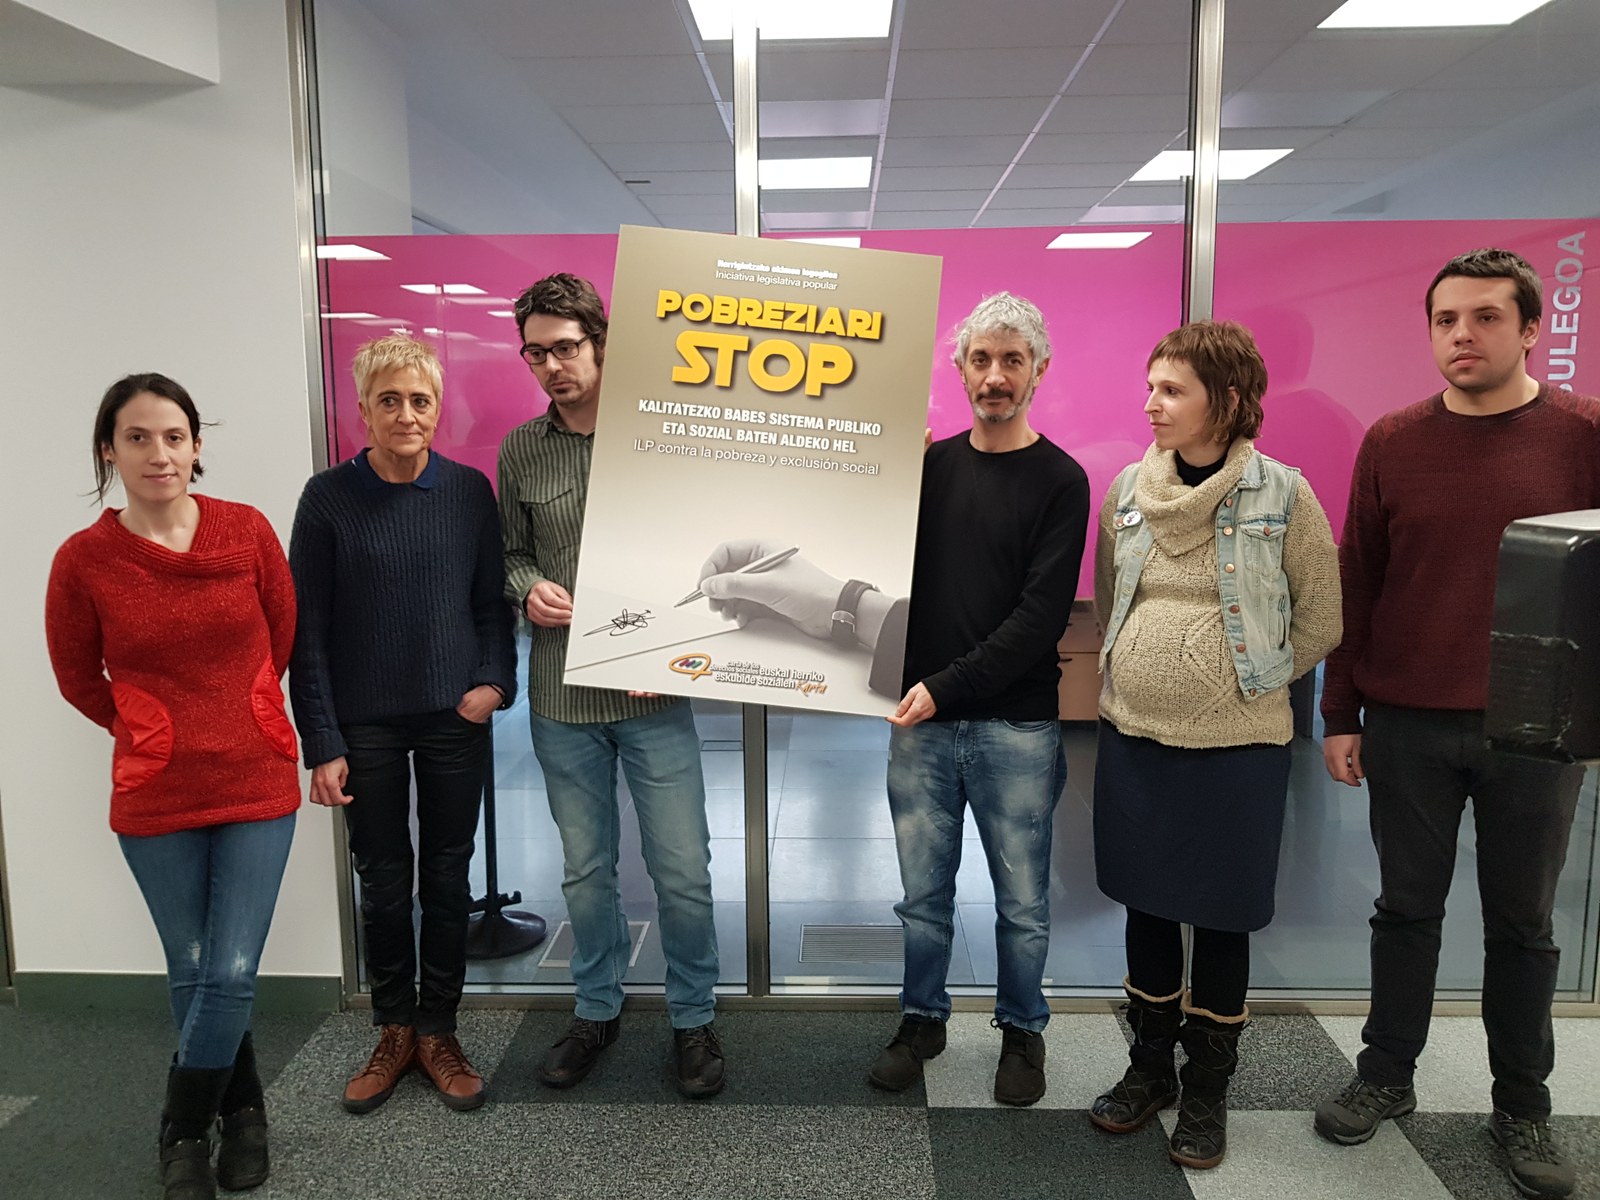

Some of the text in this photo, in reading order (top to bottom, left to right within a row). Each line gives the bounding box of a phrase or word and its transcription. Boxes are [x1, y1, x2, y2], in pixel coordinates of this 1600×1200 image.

[715, 270, 837, 291] Iniciativa legislativa popular
[656, 289, 882, 340] POBREZIARI
[671, 330, 854, 397] STOP
[638, 399, 882, 436] KALITATEZKO BABES SISTEMA PUBLIKO
[662, 421, 857, 453] ETA SOZIAL BATEN ALDEKO HEL
[633, 438, 879, 475] ILP contra la pobreza y exclusión social
[714, 671, 756, 686] eskubide
[756, 676, 795, 689] sozialen
[759, 667, 825, 683] euskal herriko
